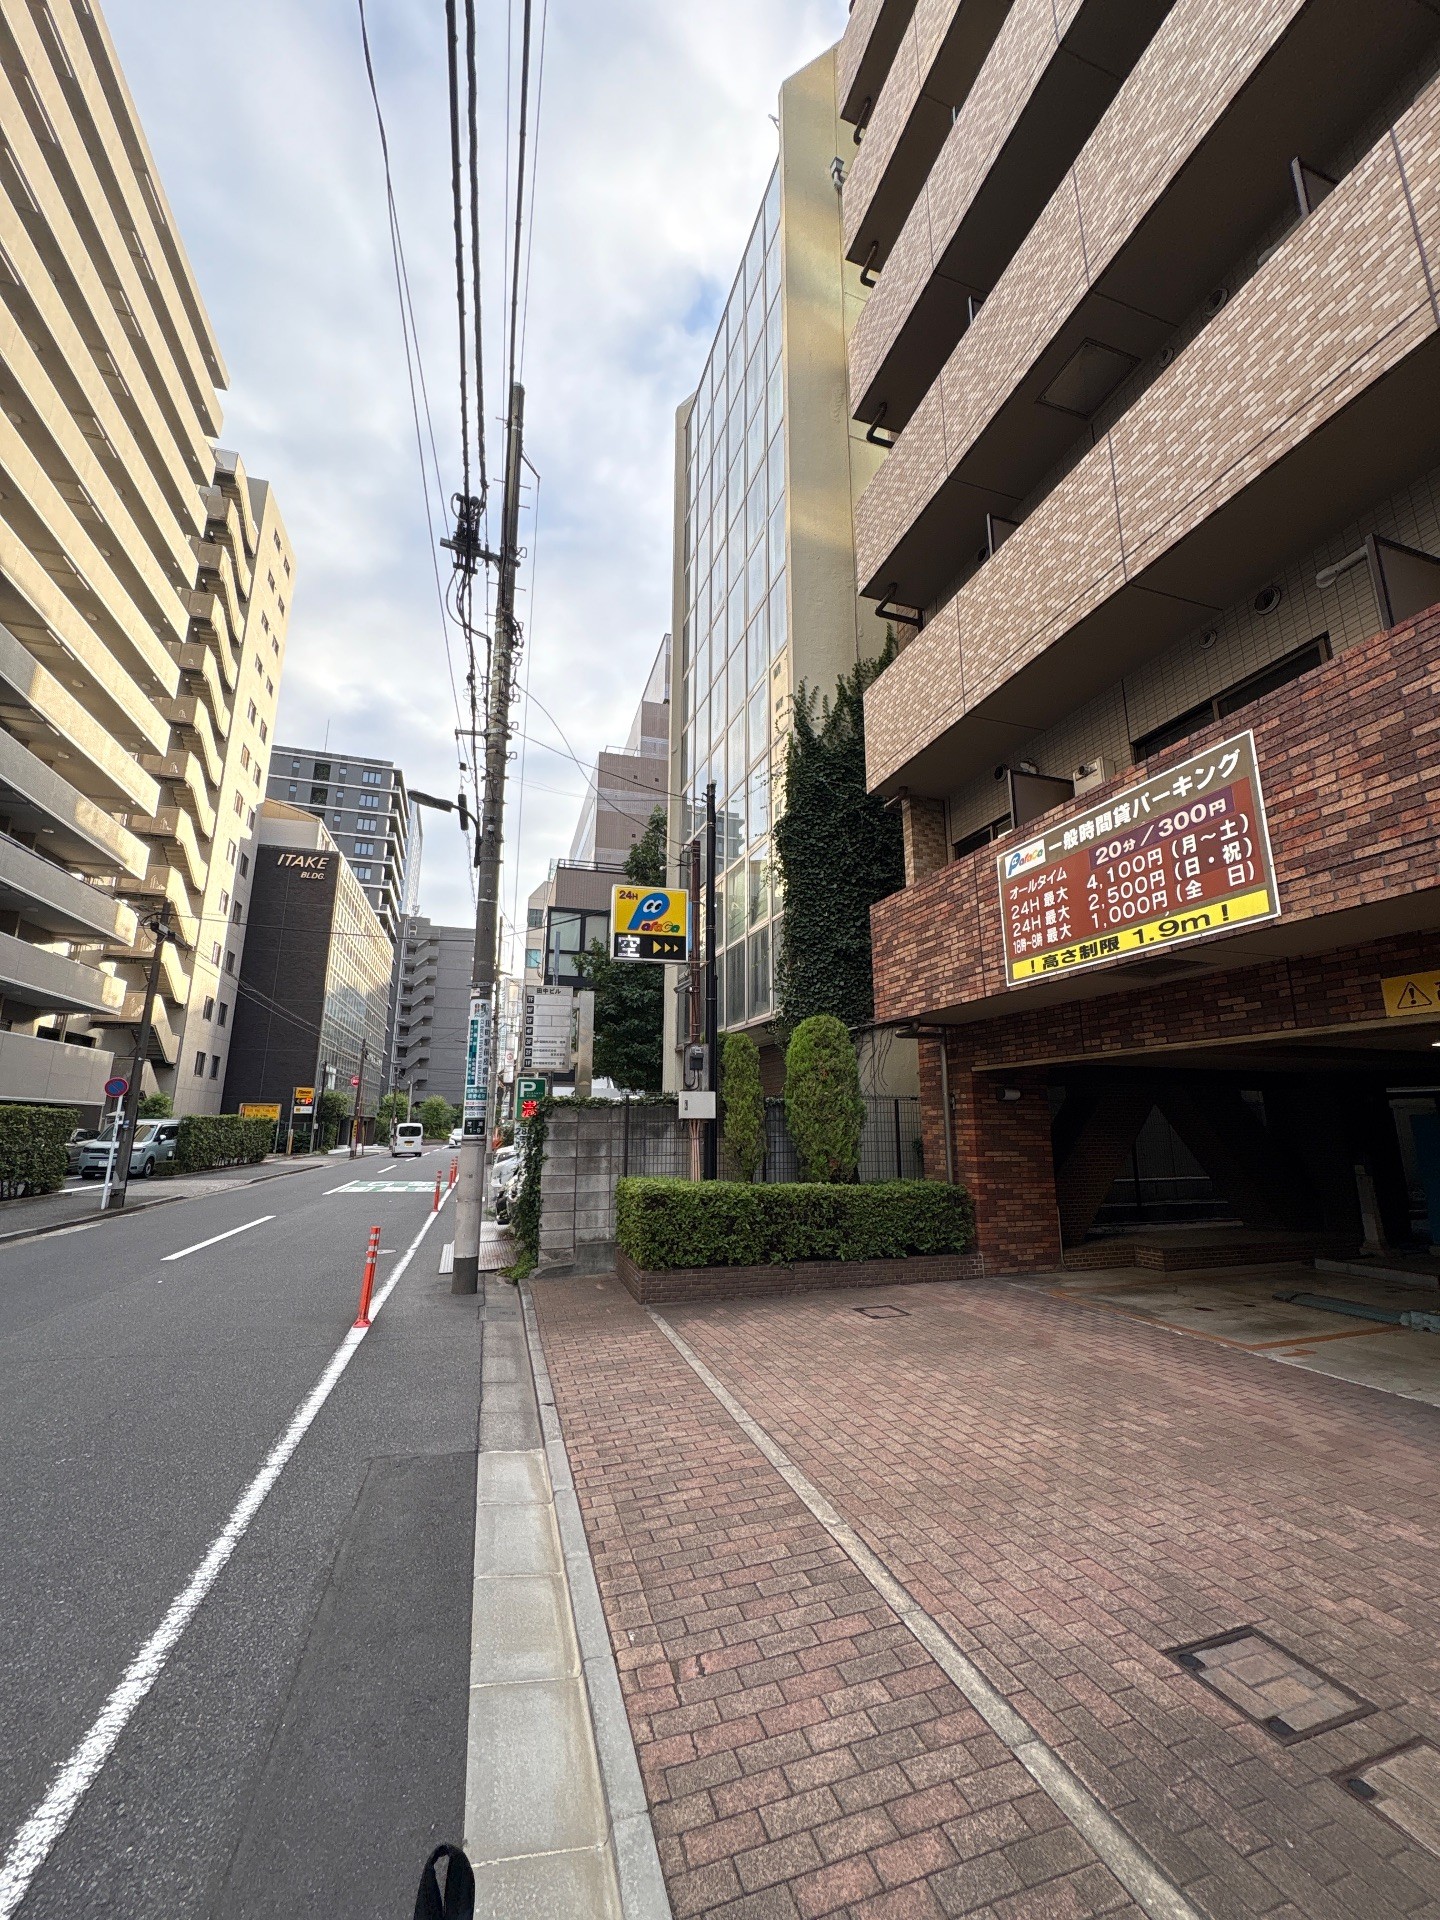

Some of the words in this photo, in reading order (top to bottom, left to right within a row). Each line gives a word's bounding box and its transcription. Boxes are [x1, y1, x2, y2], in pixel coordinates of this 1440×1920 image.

[1048, 748, 1242, 851] 一般時間貸パーキング
[277, 853, 330, 870] ITAKE
[300, 871, 326, 880] BLDG.
[618, 890, 638, 900] 24H
[1009, 867, 1068, 900] オールタイム
[1010, 897, 1041, 920] 24H
[1043, 886, 1069, 908] 最大
[1086, 847, 1164, 890] 4,100円
[1012, 915, 1041, 937] 24H
[1045, 904, 1071, 927] 最大
[1088, 869, 1166, 912] 2,500円
[1046, 922, 1072, 944] 最大
[1090, 890, 1168, 930] 1,000円
[618, 934, 640, 958] 空
[519, 1081, 537, 1098] P
